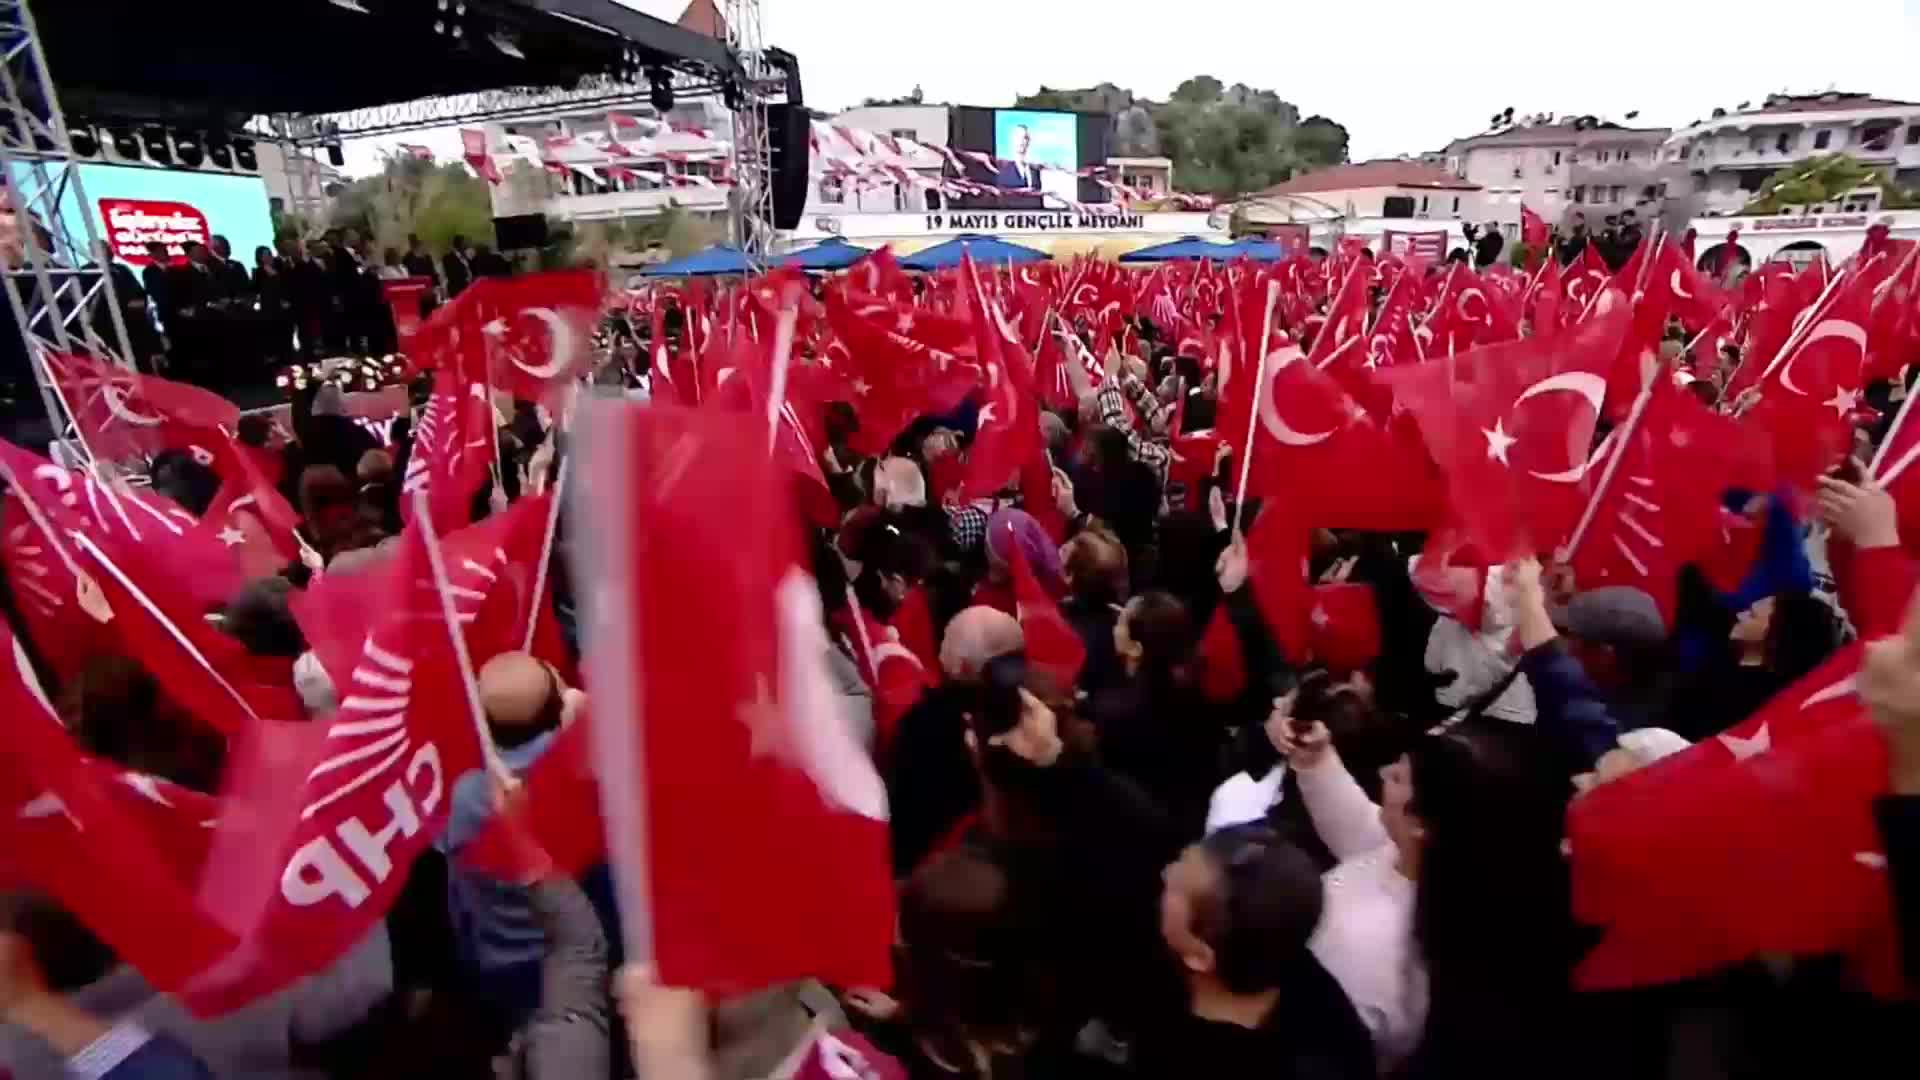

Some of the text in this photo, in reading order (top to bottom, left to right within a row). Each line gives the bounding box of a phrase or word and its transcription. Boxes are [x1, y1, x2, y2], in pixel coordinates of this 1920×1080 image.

[926, 213, 1144, 230] 19 MAYIS GENÇLİK MEYDANI
